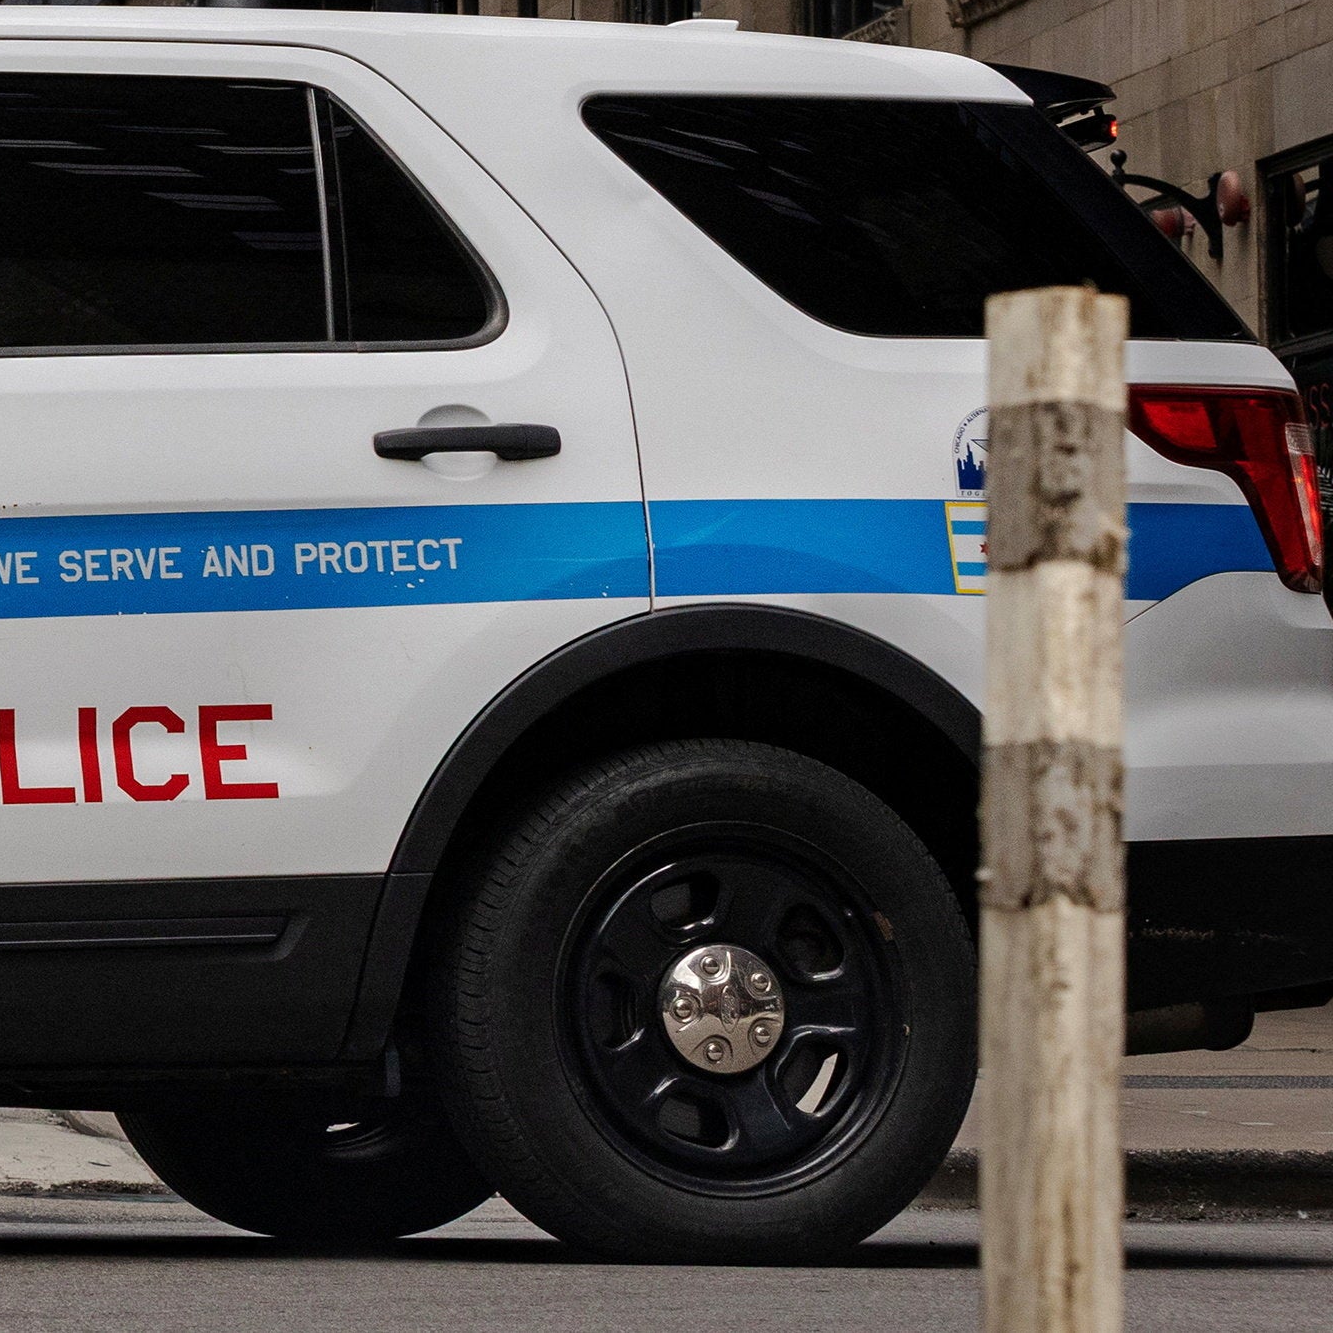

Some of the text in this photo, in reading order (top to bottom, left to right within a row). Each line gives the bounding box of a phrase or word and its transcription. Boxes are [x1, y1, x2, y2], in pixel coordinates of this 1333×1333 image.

[58, 546, 184, 583] SERVE
[201, 544, 275, 578] AND
[294, 537, 463, 575] PROTECT
